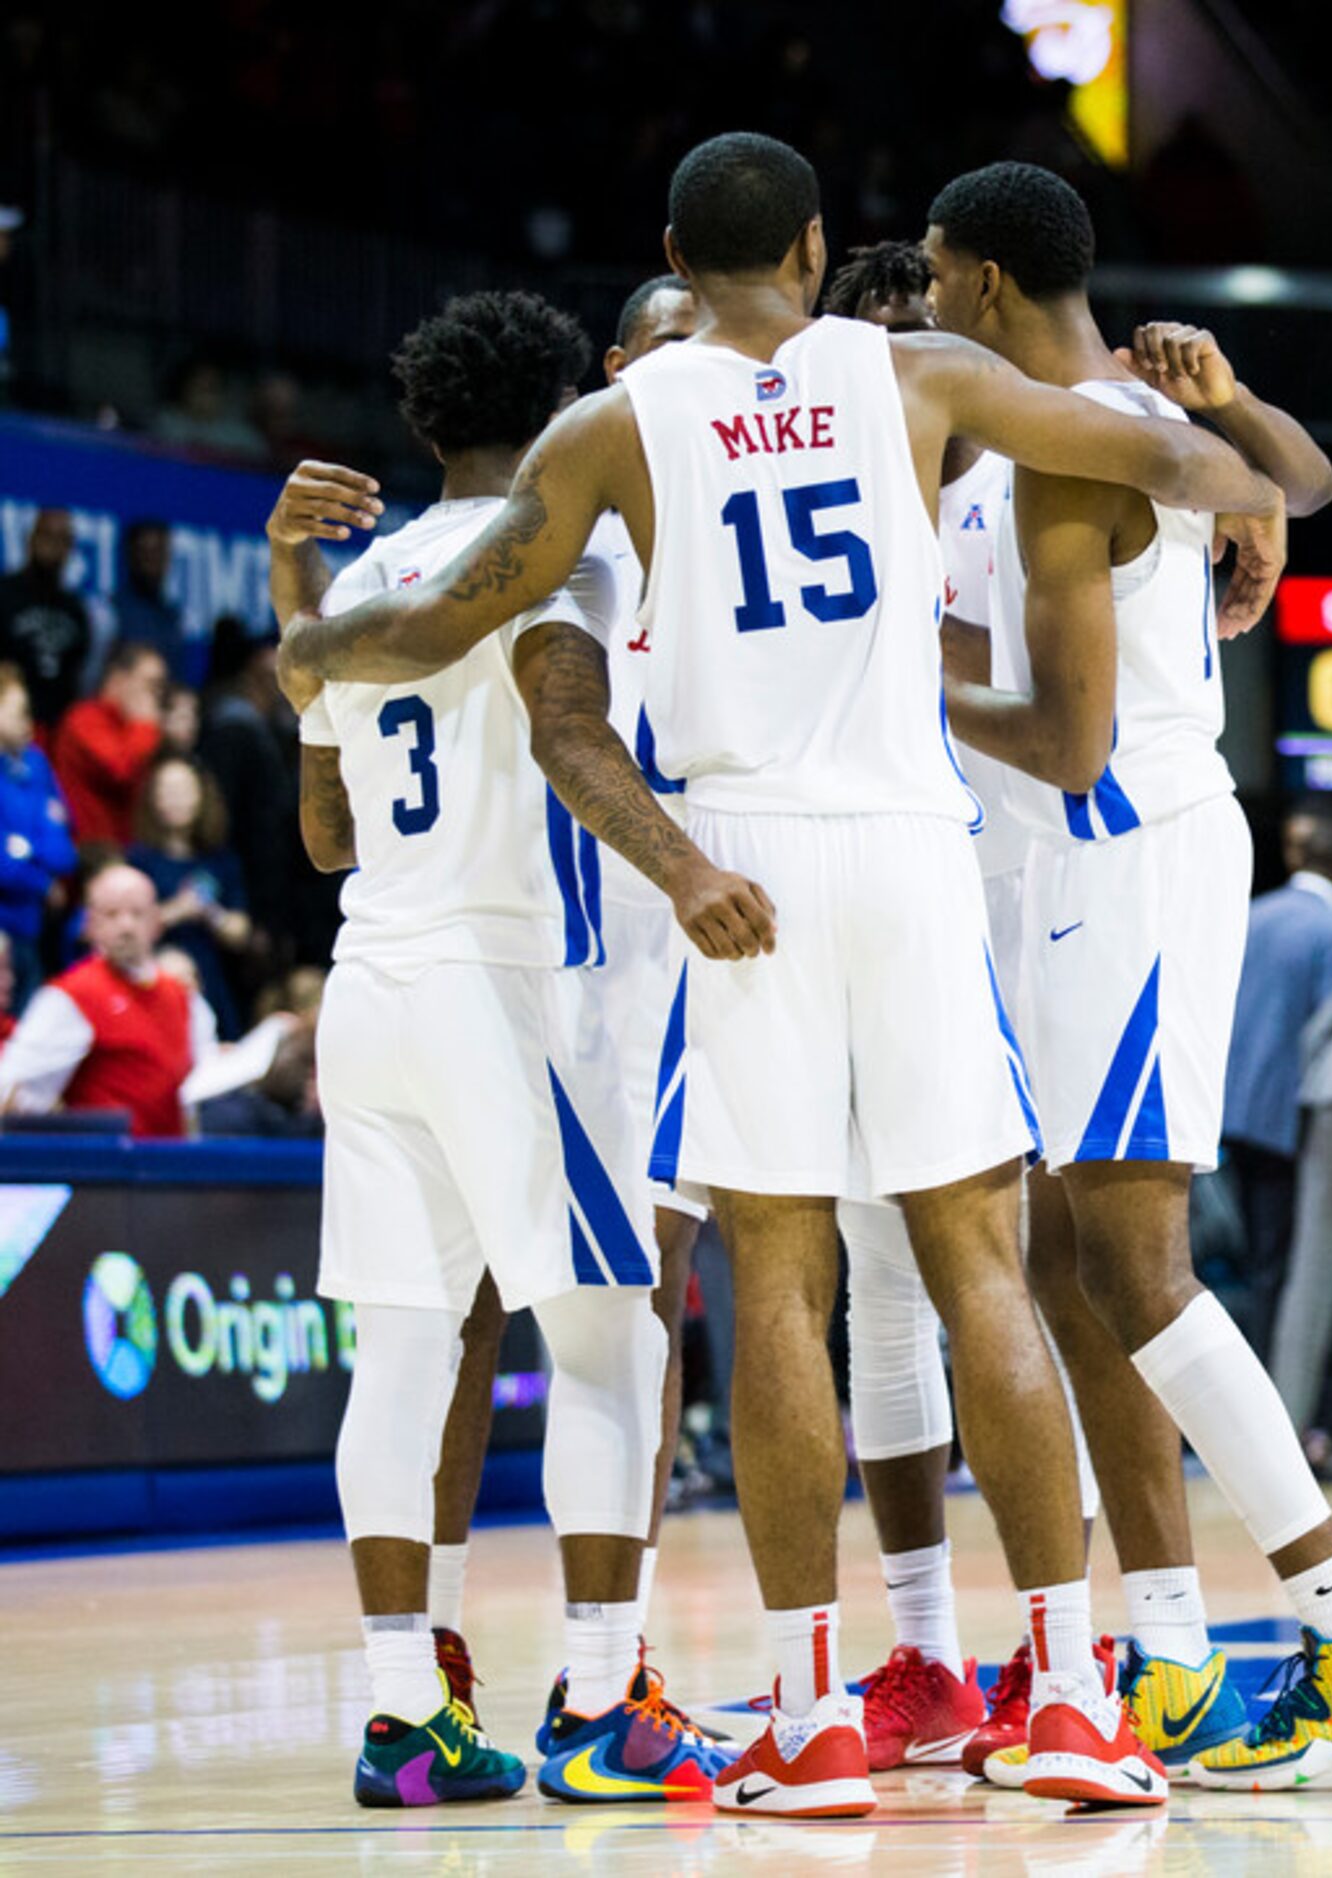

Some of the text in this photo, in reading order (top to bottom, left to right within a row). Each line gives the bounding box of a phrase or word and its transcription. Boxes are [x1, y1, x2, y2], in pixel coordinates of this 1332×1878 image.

[710, 405, 835, 461] MIKE
[721, 477, 878, 634] 15
[378, 694, 440, 836] 3
[165, 1271, 328, 1404] Origin
